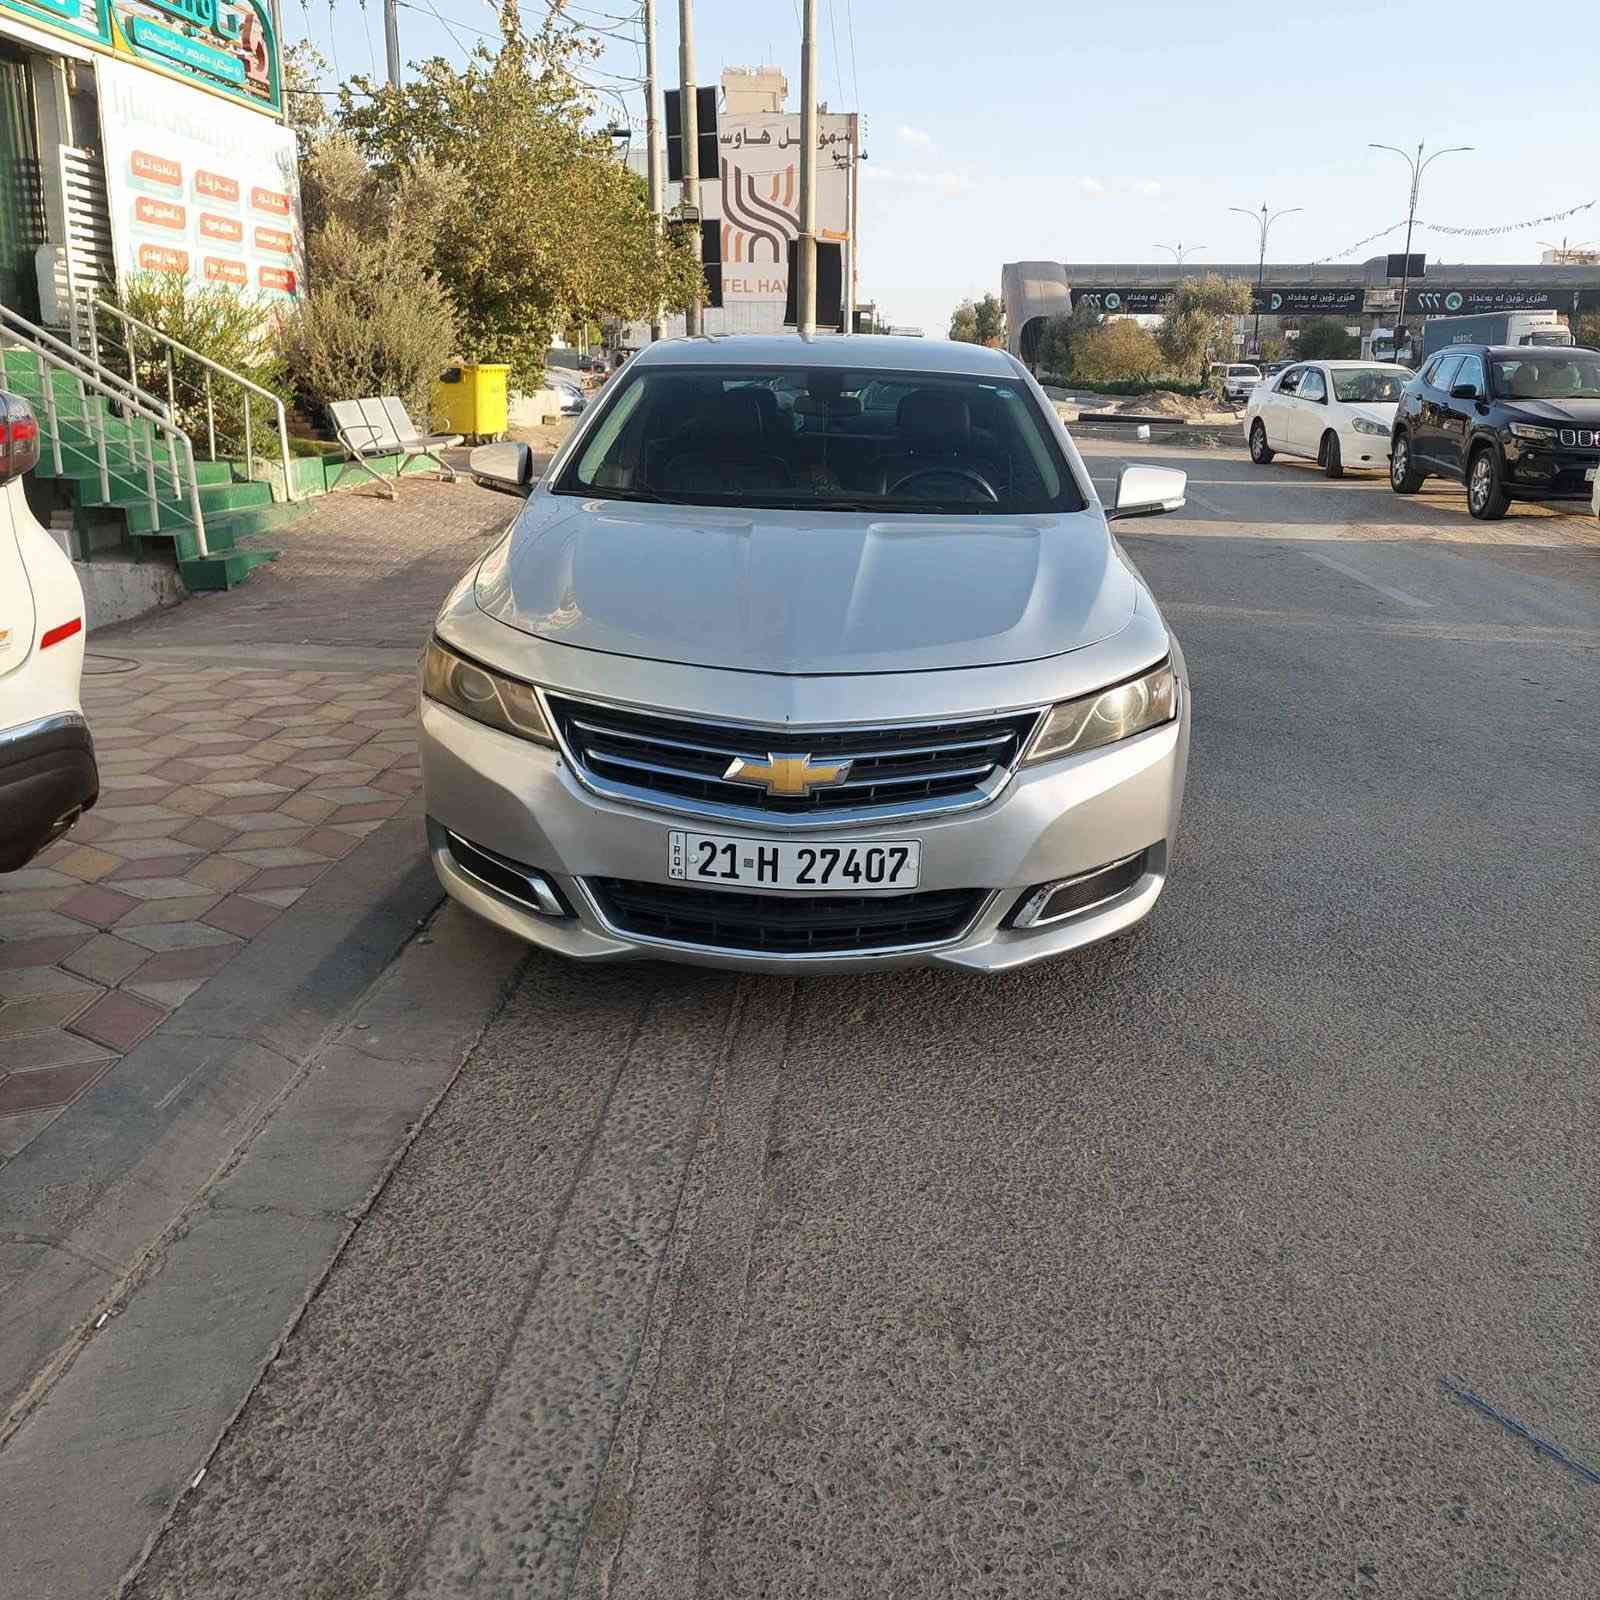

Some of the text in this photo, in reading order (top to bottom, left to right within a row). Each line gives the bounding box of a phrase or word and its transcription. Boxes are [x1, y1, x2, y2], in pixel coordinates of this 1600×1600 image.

[720, 127, 771, 150] هاوس
[721, 279, 786, 293] TEL HA
[697, 840, 909, 884] 21 H 27407
